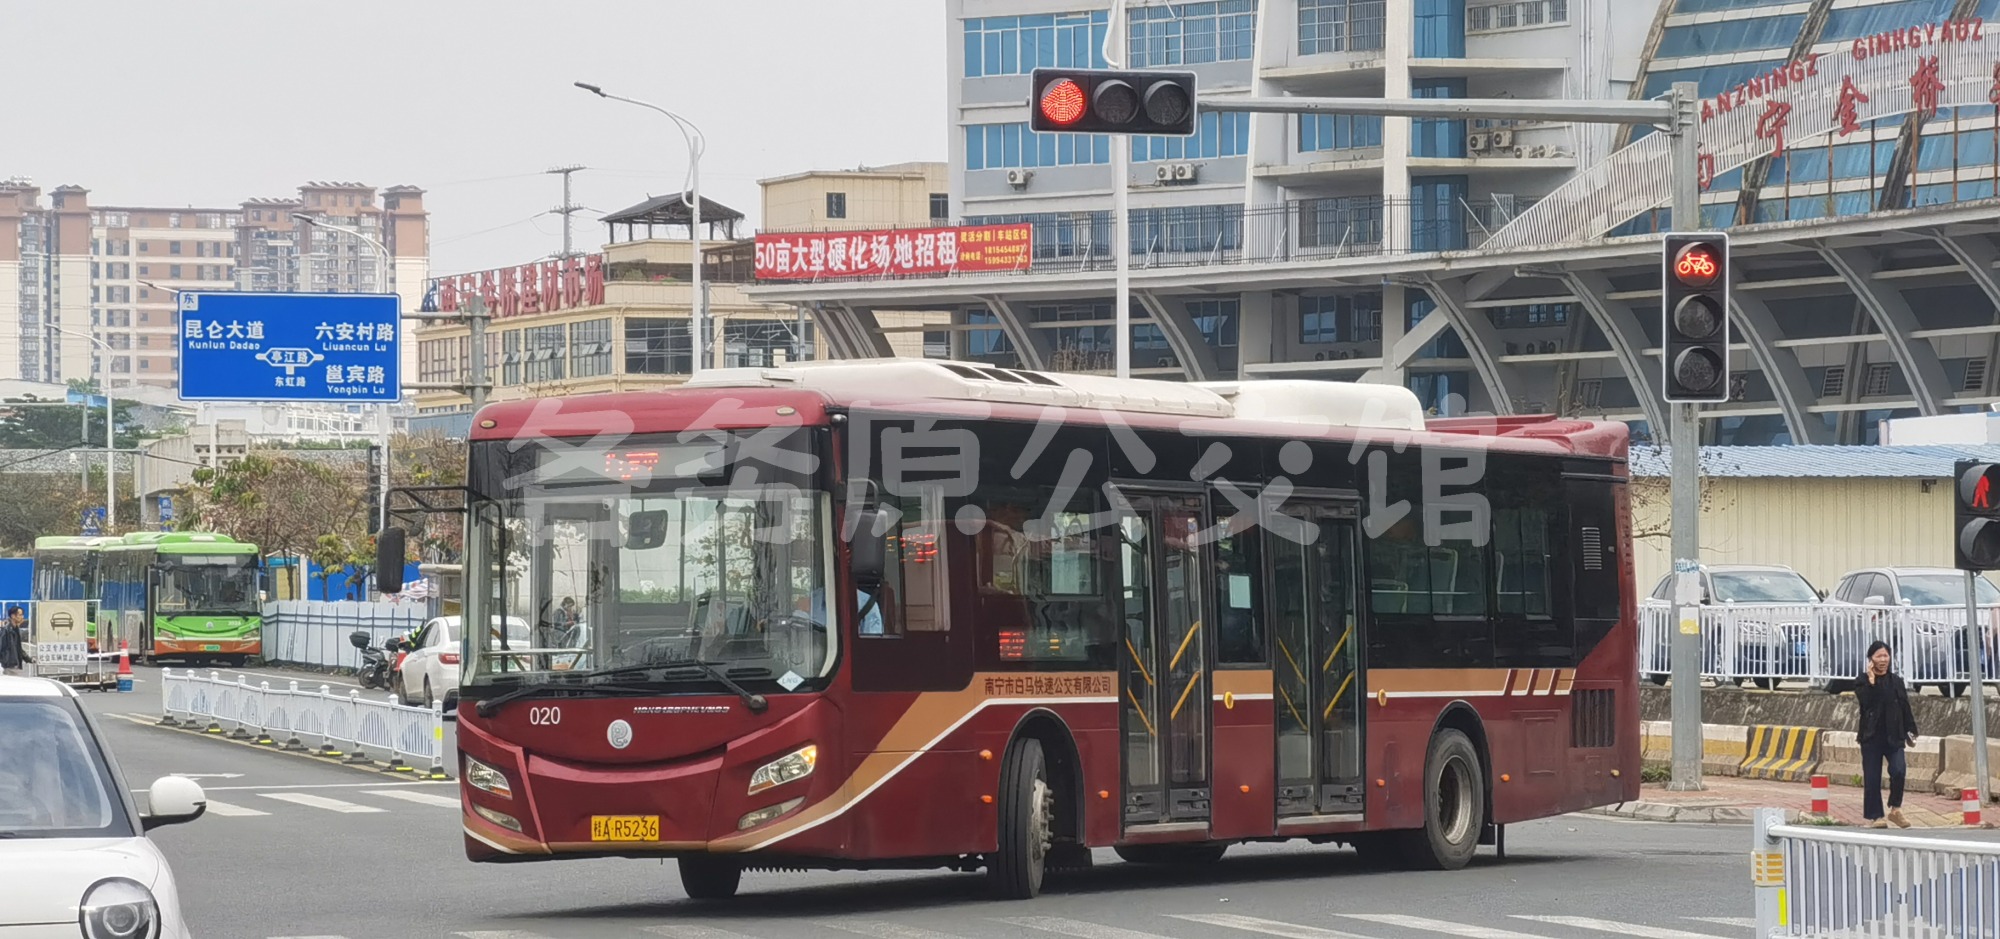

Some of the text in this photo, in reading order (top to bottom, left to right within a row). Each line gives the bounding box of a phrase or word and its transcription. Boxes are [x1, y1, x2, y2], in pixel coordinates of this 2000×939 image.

[1701, 52, 1818, 123] ANZNINGZ
[755, 231, 957, 273] 50亩大型硬化场地招租
[440, 254, 605, 324] 南宁金桥建材市场
[184, 294, 194, 304] 东
[185, 319, 265, 339] 昆仑大道
[315, 322, 395, 341] 六安村路
[189, 341, 260, 350] Kunlun Dadao
[322, 342, 387, 351] Liuancun Lu
[271, 351, 309, 363] 亭江路
[274, 376, 306, 387] 东虹路
[326, 365, 385, 384] 邕宾路
[327, 385, 385, 395] Yongbin Lu
[984, 676, 1111, 695] 南宁市白马快速公交有限公司
[530, 707, 561, 725] 020
